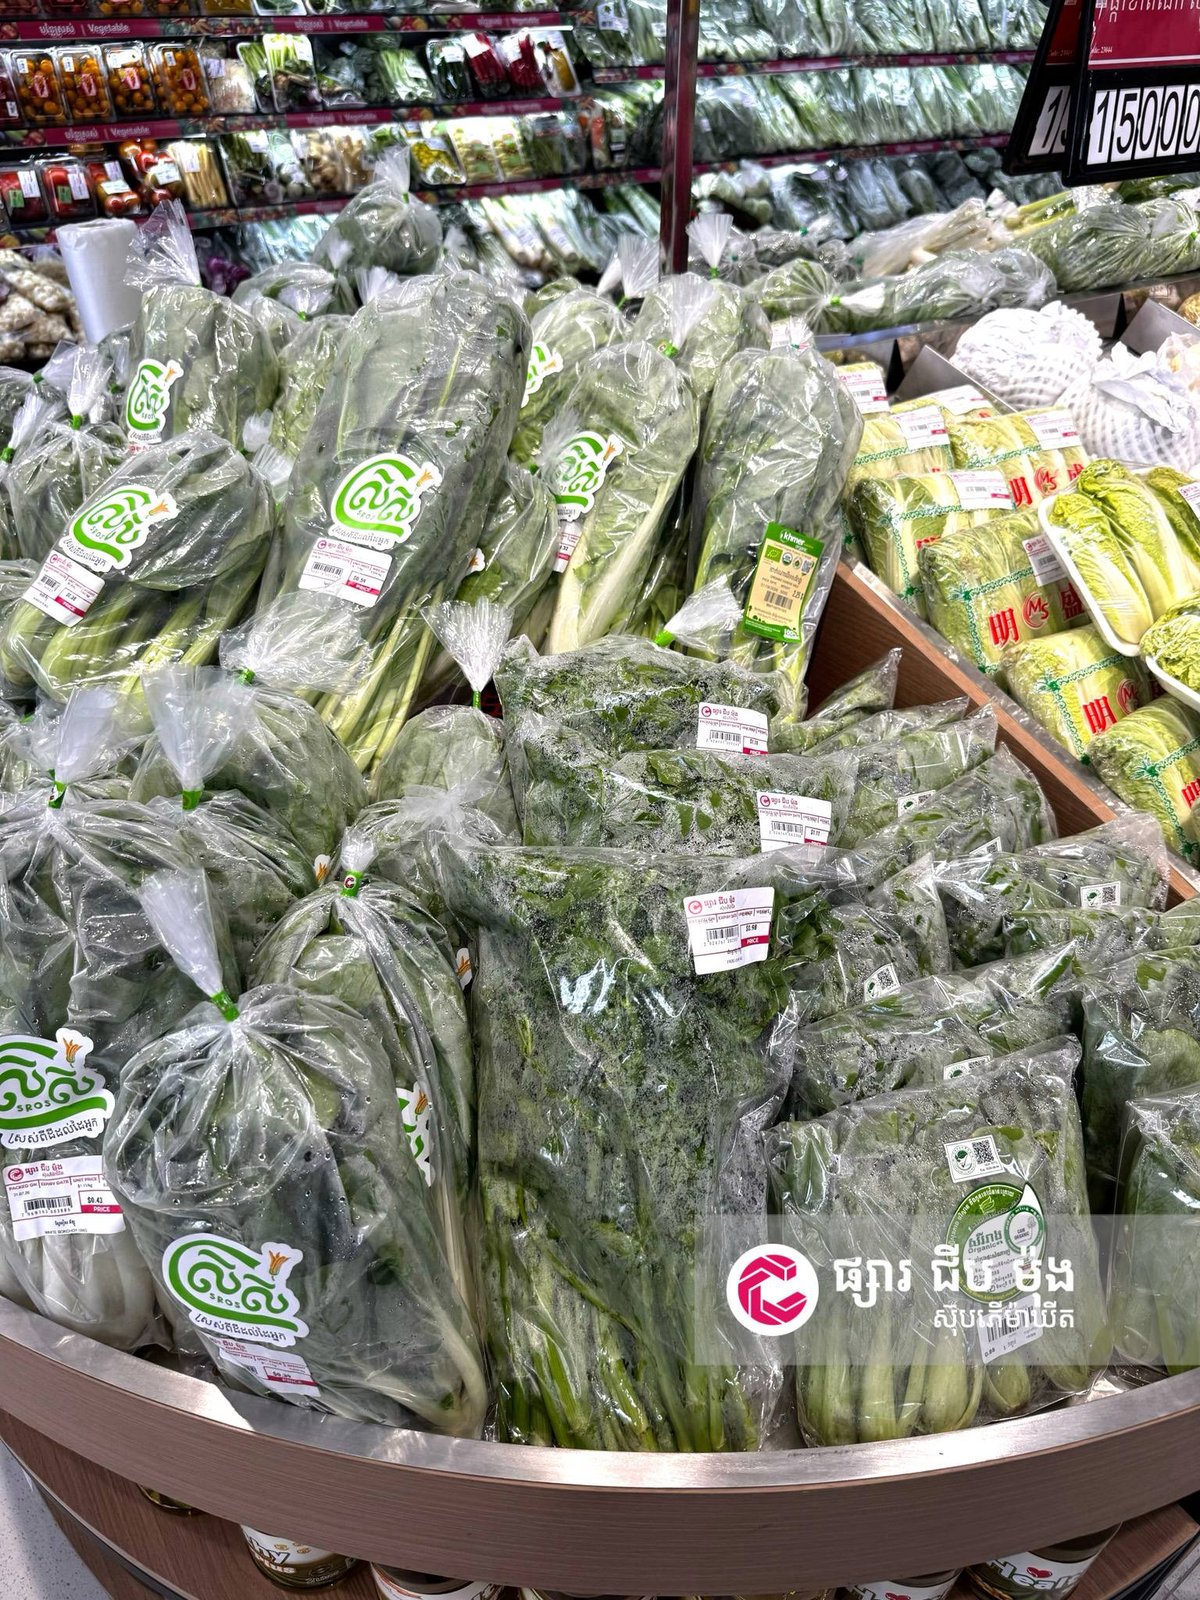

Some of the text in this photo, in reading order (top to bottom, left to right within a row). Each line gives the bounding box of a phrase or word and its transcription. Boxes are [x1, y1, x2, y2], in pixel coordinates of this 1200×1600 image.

[87, 22, 130, 36] Vegetable
[1096, 89, 1200, 155] 15000
[110, 126, 151, 137] Vegetable
[783, 531, 806, 545] khmer
[988, 608, 1020, 648] 明
[1083, 696, 1118, 735] 明
[17, 1100, 51, 1112] SROS
[968, 1241, 998, 1254] Organic
[209, 1292, 241, 1309] SROS
